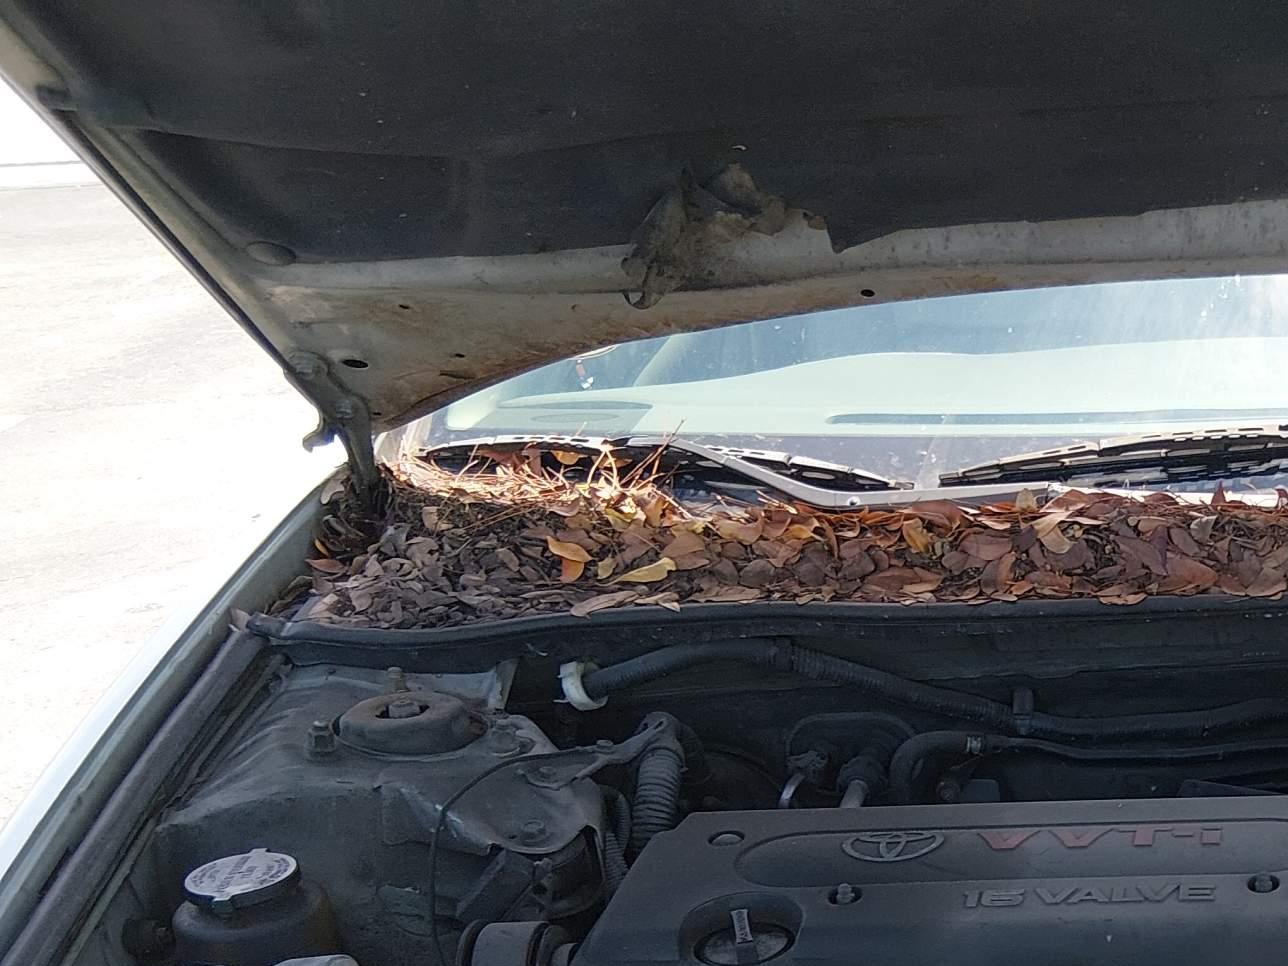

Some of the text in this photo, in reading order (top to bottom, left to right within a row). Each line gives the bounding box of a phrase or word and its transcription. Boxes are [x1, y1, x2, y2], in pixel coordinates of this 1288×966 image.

[976, 827, 1224, 850] VVT-i
[962, 882, 1217, 908] 16 VALVE
